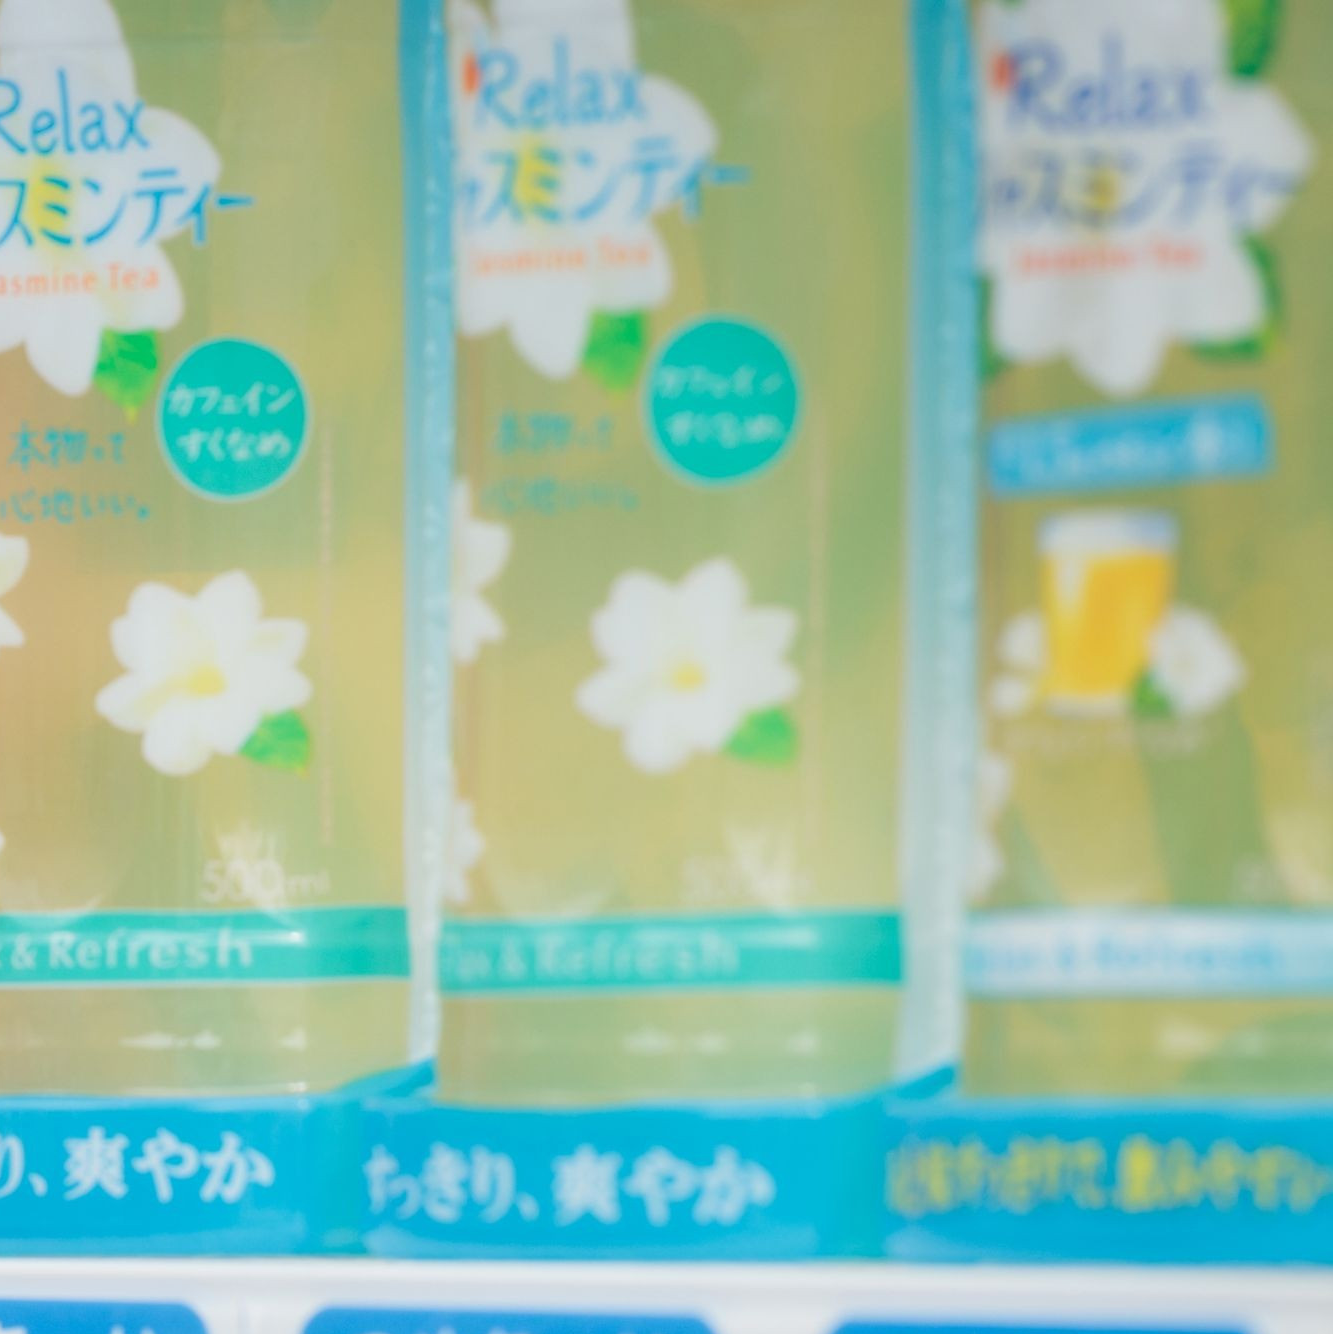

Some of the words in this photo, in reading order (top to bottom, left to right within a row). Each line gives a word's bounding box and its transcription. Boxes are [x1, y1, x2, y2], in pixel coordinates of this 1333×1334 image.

[475, 36, 646, 129] Relax
[107, 261, 160, 293] Tea
[166, 383, 296, 418] カフェイン
[175, 427, 292, 462] すくなめ
[11, 931, 37, 970] &
[48, 923, 254, 970] Refresh
